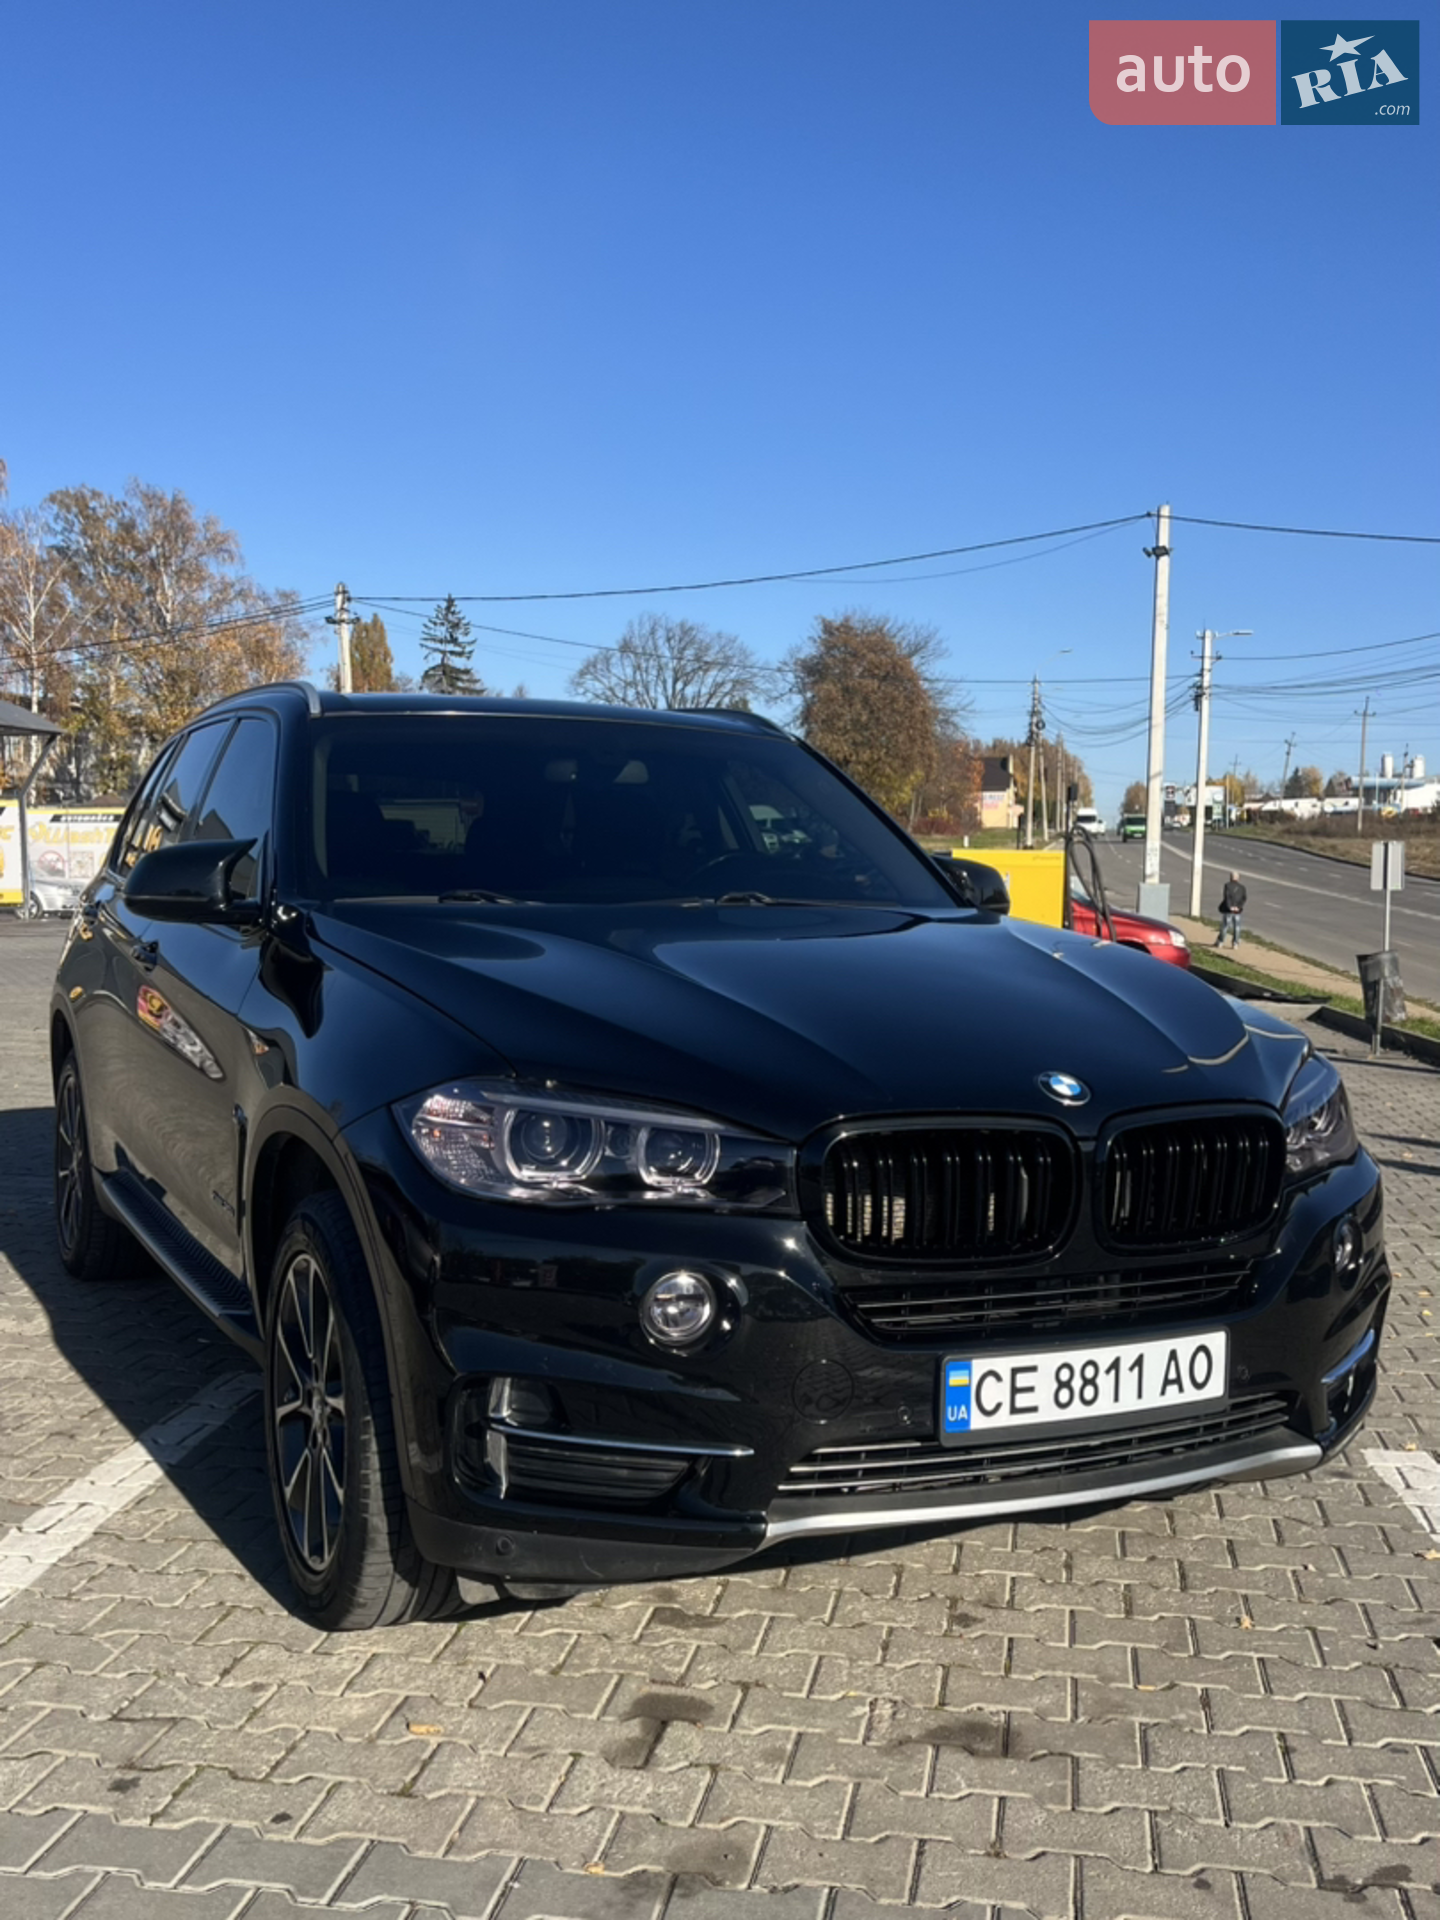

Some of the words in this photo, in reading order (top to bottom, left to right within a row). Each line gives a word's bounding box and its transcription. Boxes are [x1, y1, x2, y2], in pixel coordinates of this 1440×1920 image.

[975, 1364, 1039, 1418] CE
[1053, 1352, 1145, 1410] 8811
[1159, 1343, 1213, 1397] AO
[947, 1404, 969, 1422] UA
